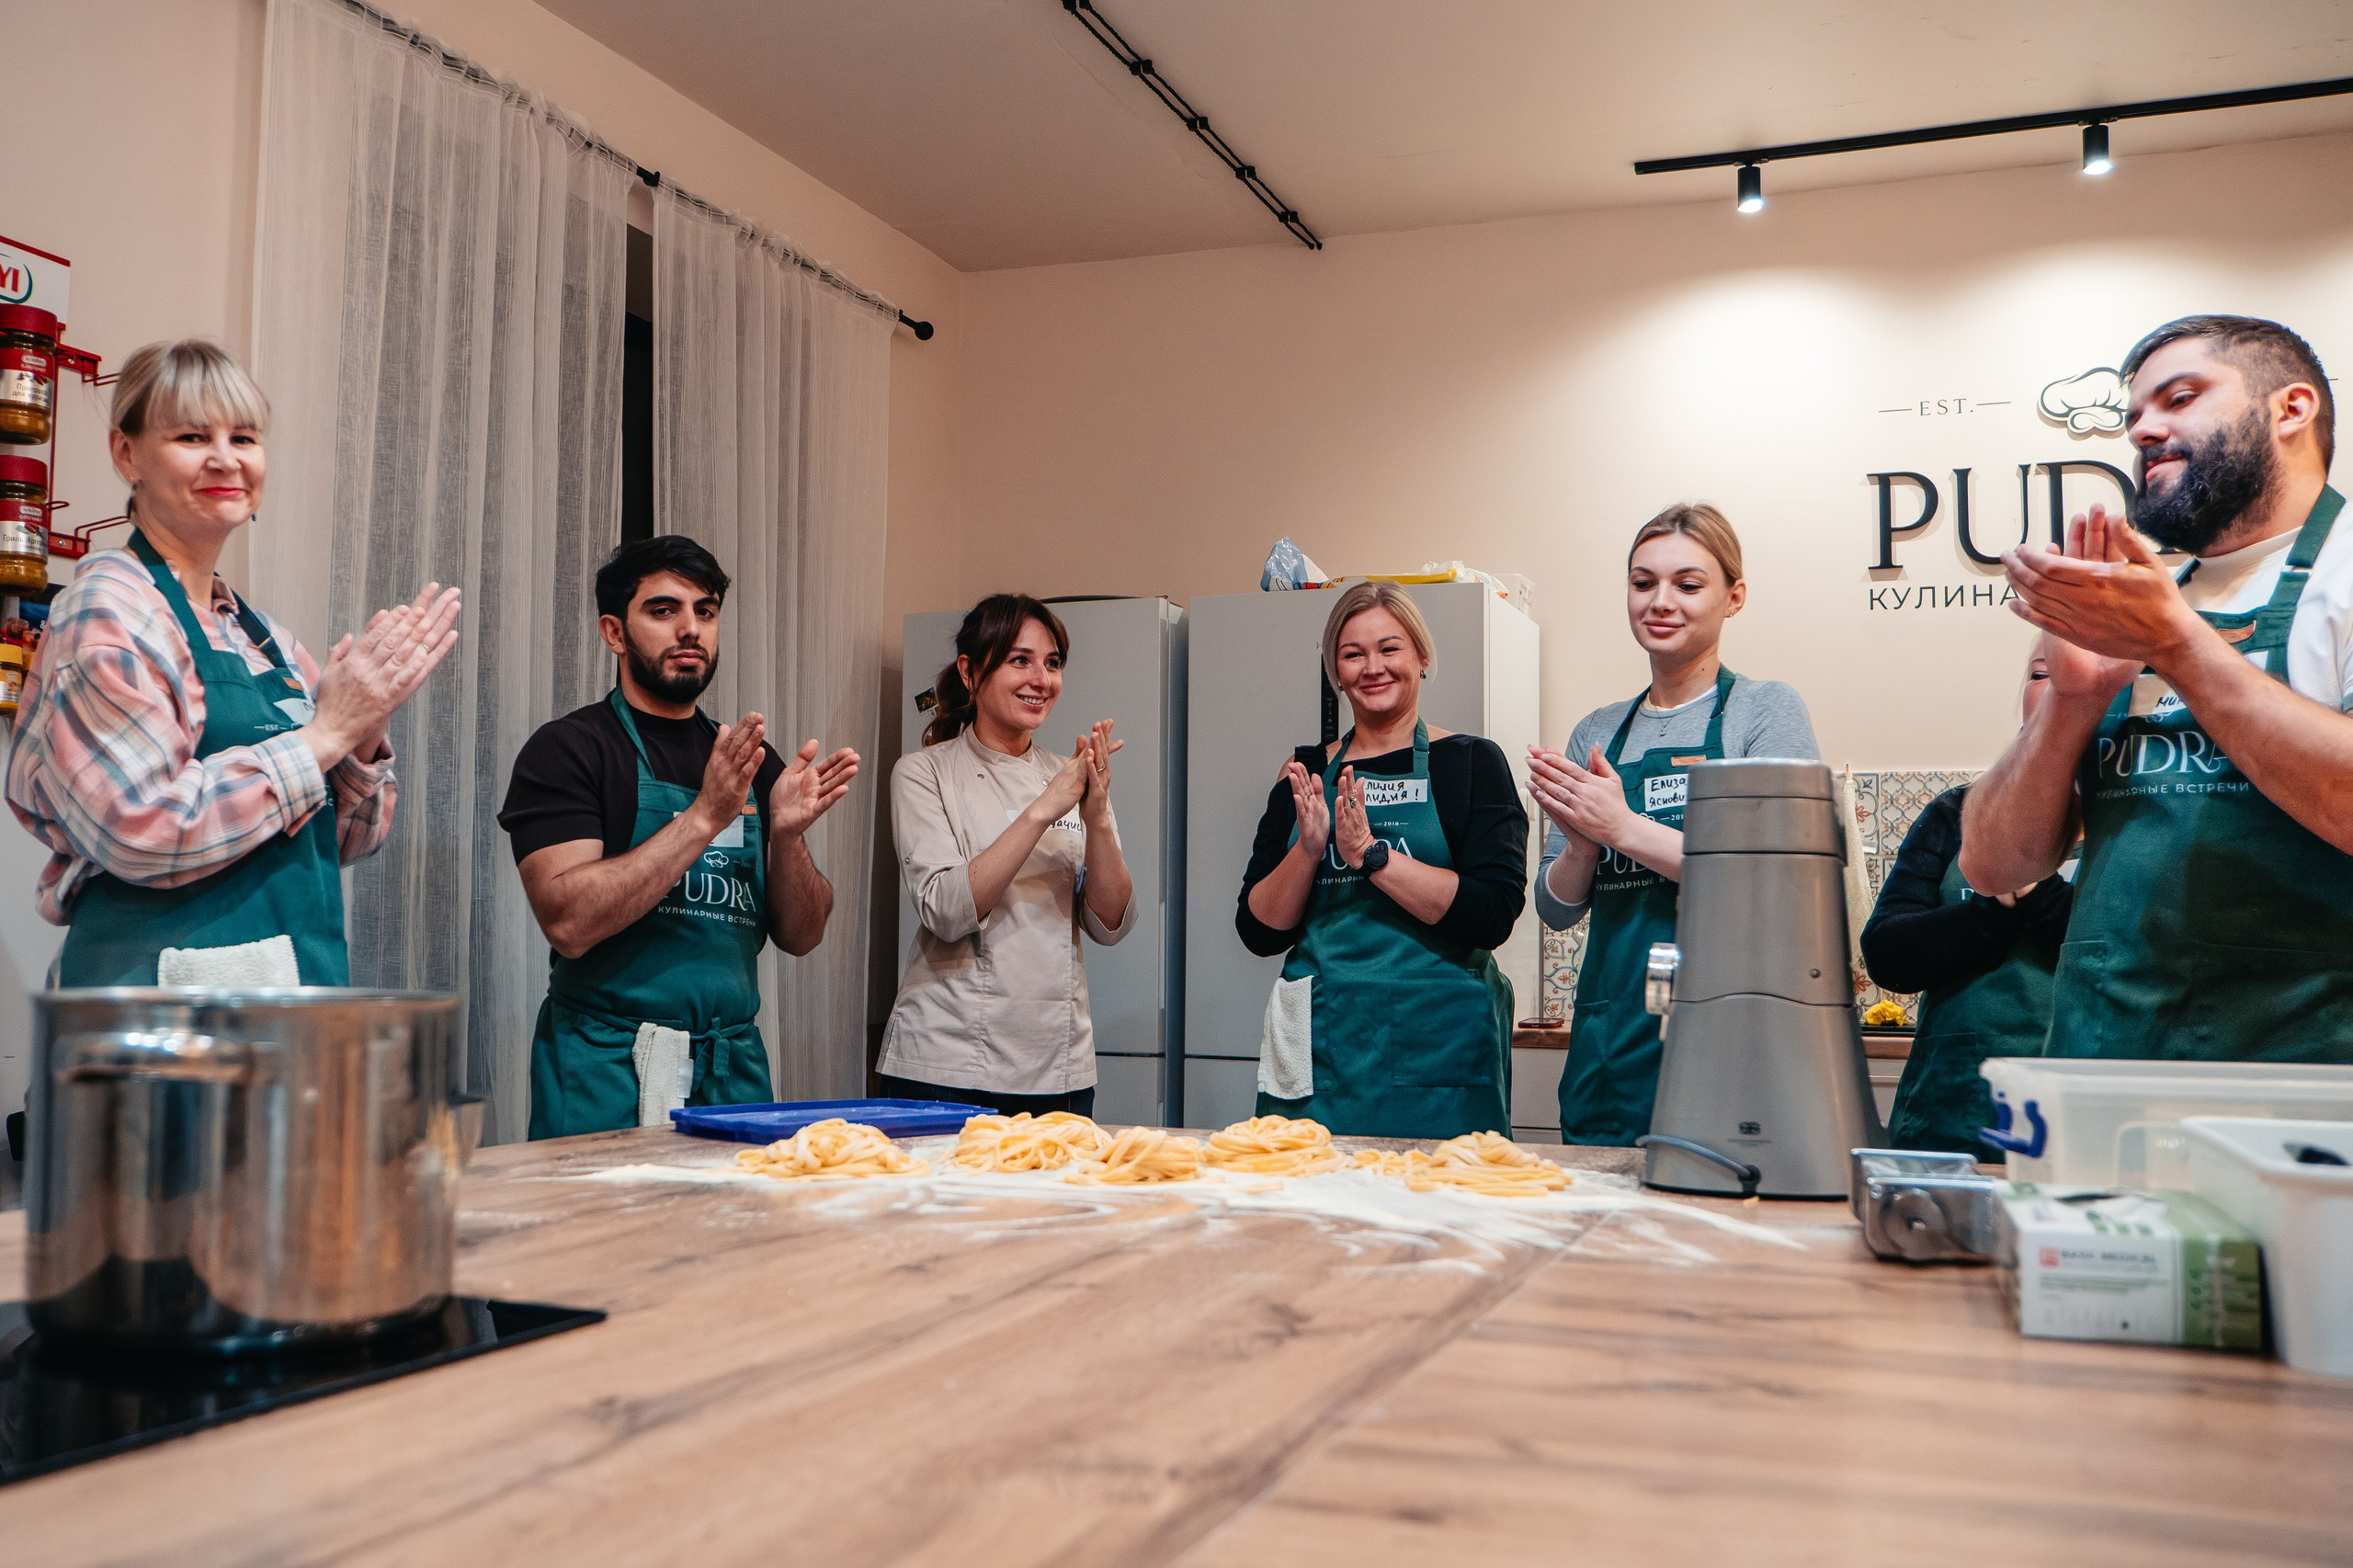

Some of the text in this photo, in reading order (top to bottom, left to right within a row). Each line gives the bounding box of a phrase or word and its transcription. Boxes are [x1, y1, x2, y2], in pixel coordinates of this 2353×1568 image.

[0, 263, 19, 292] YI
[1919, 398, 1974, 416] EST.
[1867, 459, 2138, 572] PUD
[1869, 583, 2021, 611] КУЛИНА
[1651, 777, 1687, 792] Елиза
[2176, 782, 2250, 794] ВСТРЕЧИ
[657, 905, 725, 921] КУЛИНАРНЫЕ
